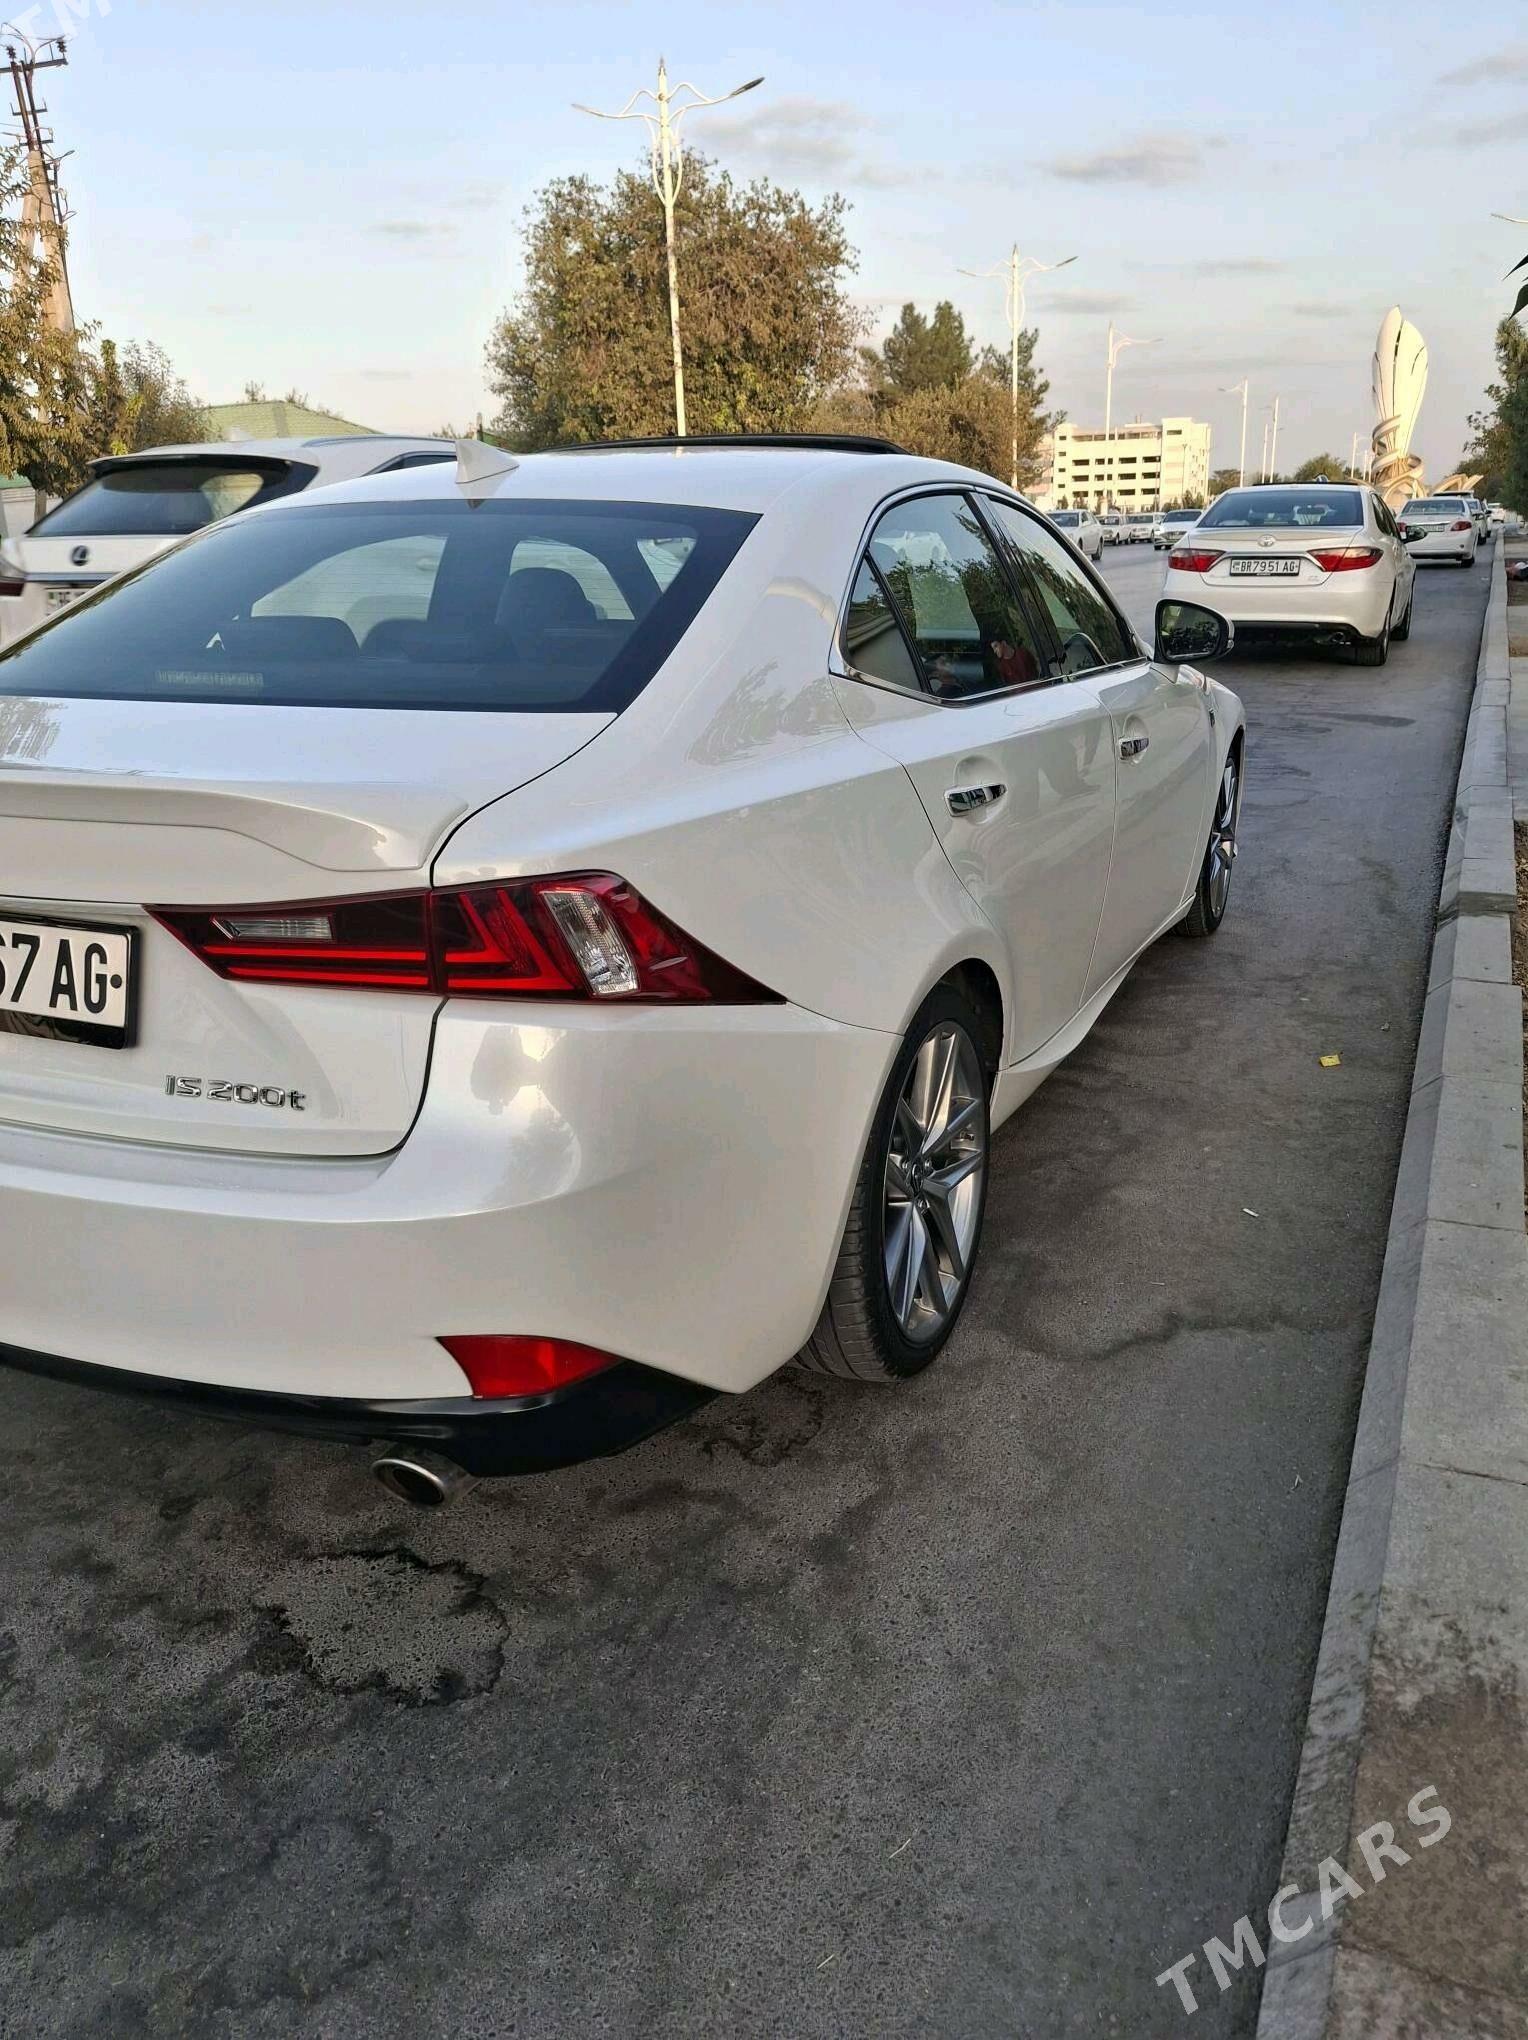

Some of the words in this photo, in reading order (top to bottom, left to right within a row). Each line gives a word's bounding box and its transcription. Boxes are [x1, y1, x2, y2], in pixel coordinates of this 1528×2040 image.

[1282, 561, 1295, 572] AG
[0, 931, 41, 1003] 7
[49, 938, 108, 1014] AG
[165, 1074, 202, 1098] IS
[206, 1079, 306, 1111] 200t
